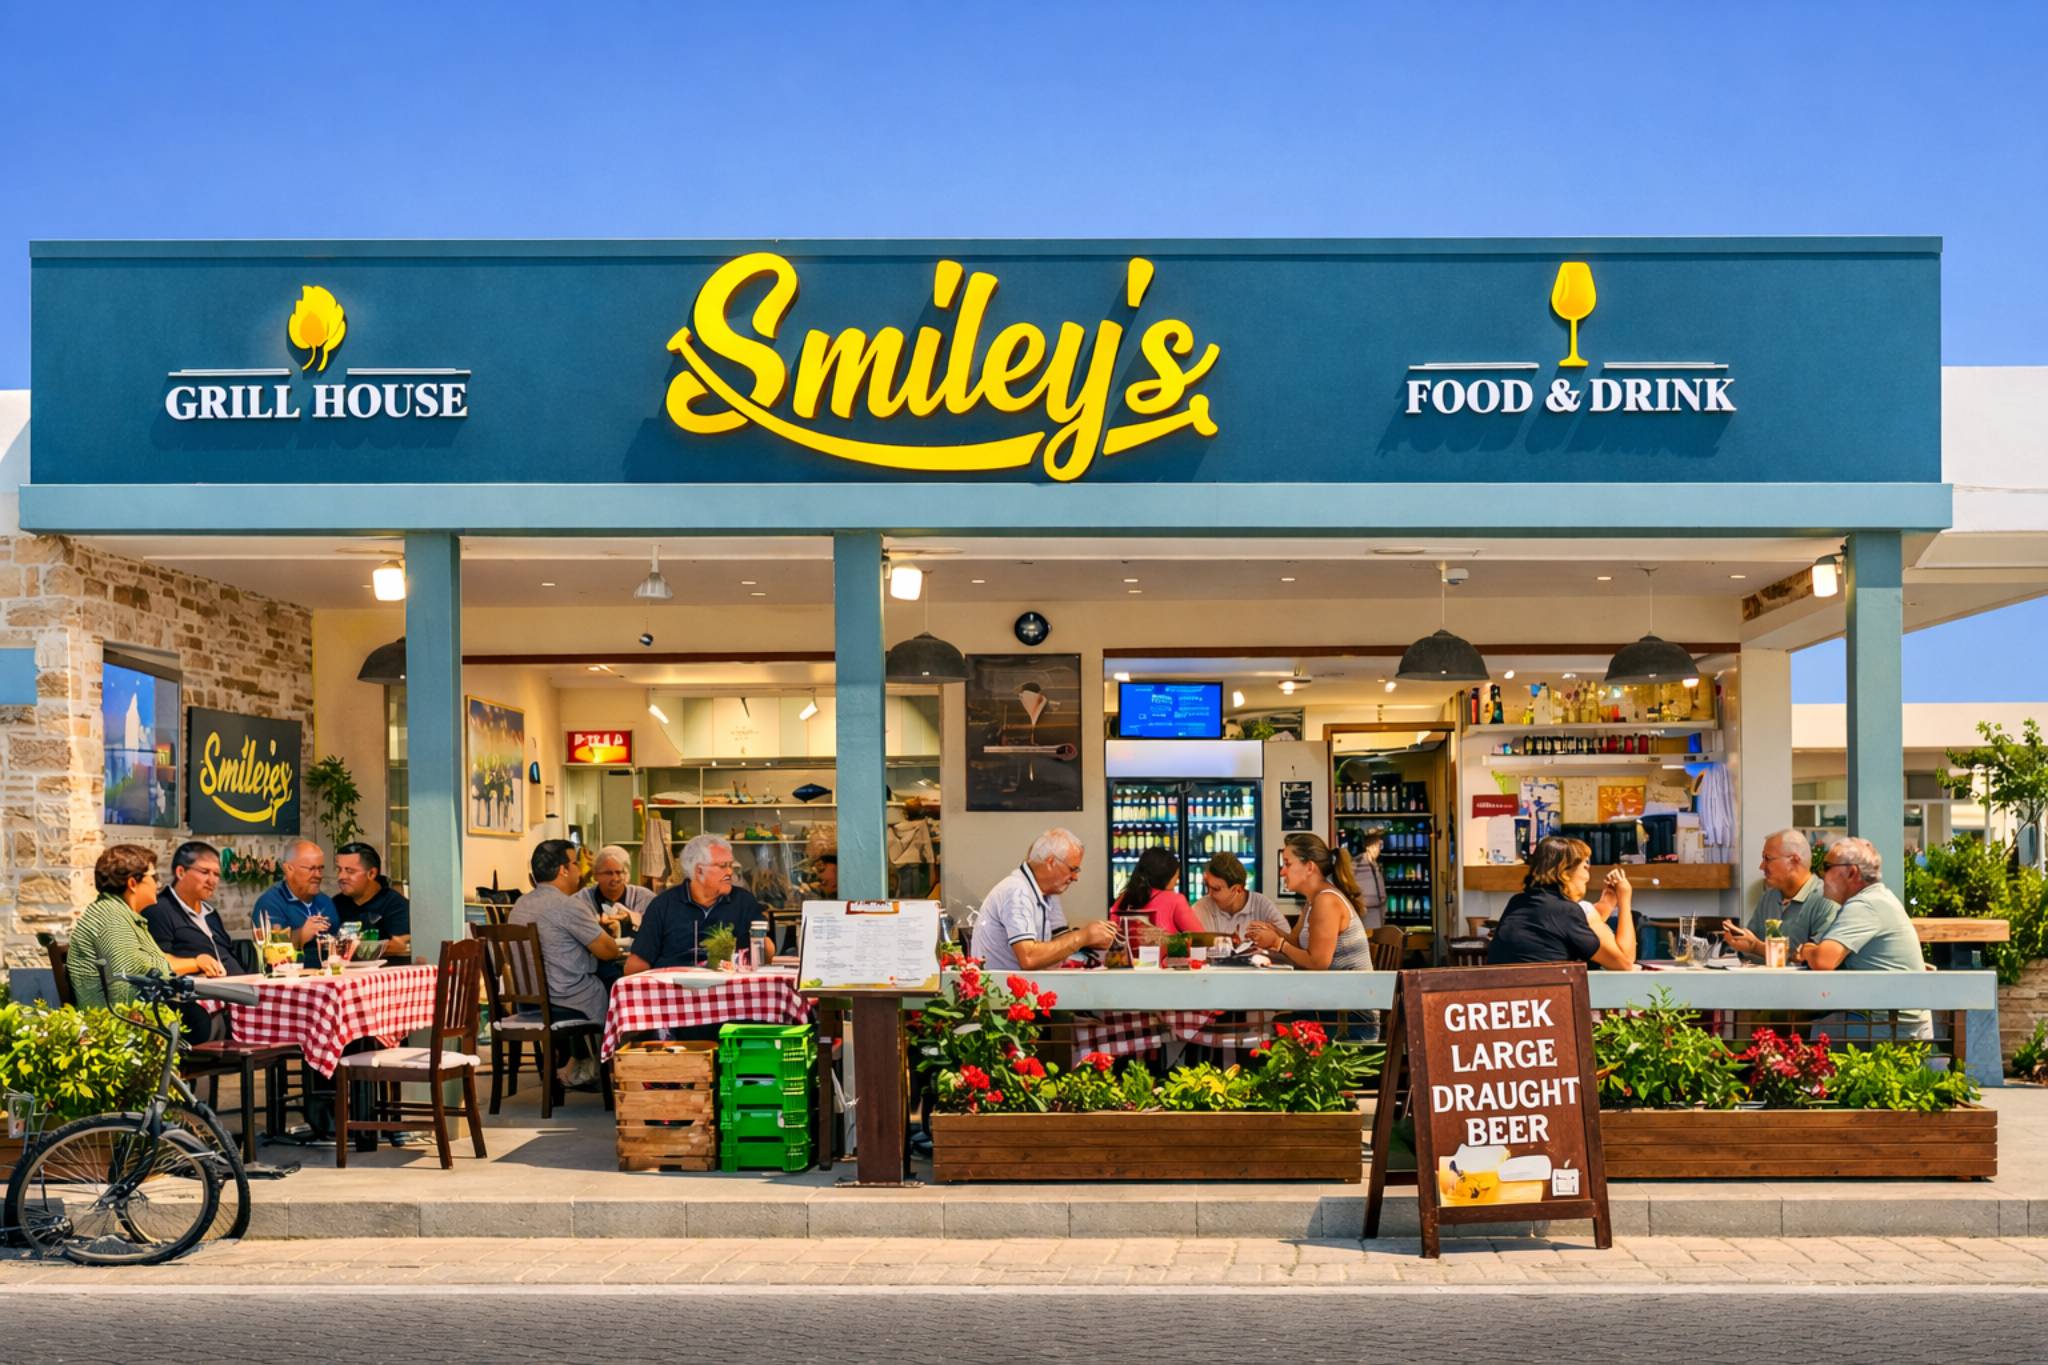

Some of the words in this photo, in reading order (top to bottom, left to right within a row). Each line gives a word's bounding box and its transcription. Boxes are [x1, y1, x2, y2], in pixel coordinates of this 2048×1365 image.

[666, 252, 1220, 481] Smiley's
[165, 384, 301, 420] GRILL
[311, 383, 469, 418] HOUSE
[1404, 379, 1533, 414] FOOD
[1545, 378, 1581, 413] &
[1589, 378, 1737, 412] DRINK
[1443, 999, 1554, 1031] GREEK
[1451, 1039, 1558, 1073] LARGE
[1431, 1076, 1581, 1113] DRAUGHT
[1465, 1114, 1550, 1146] BEER
